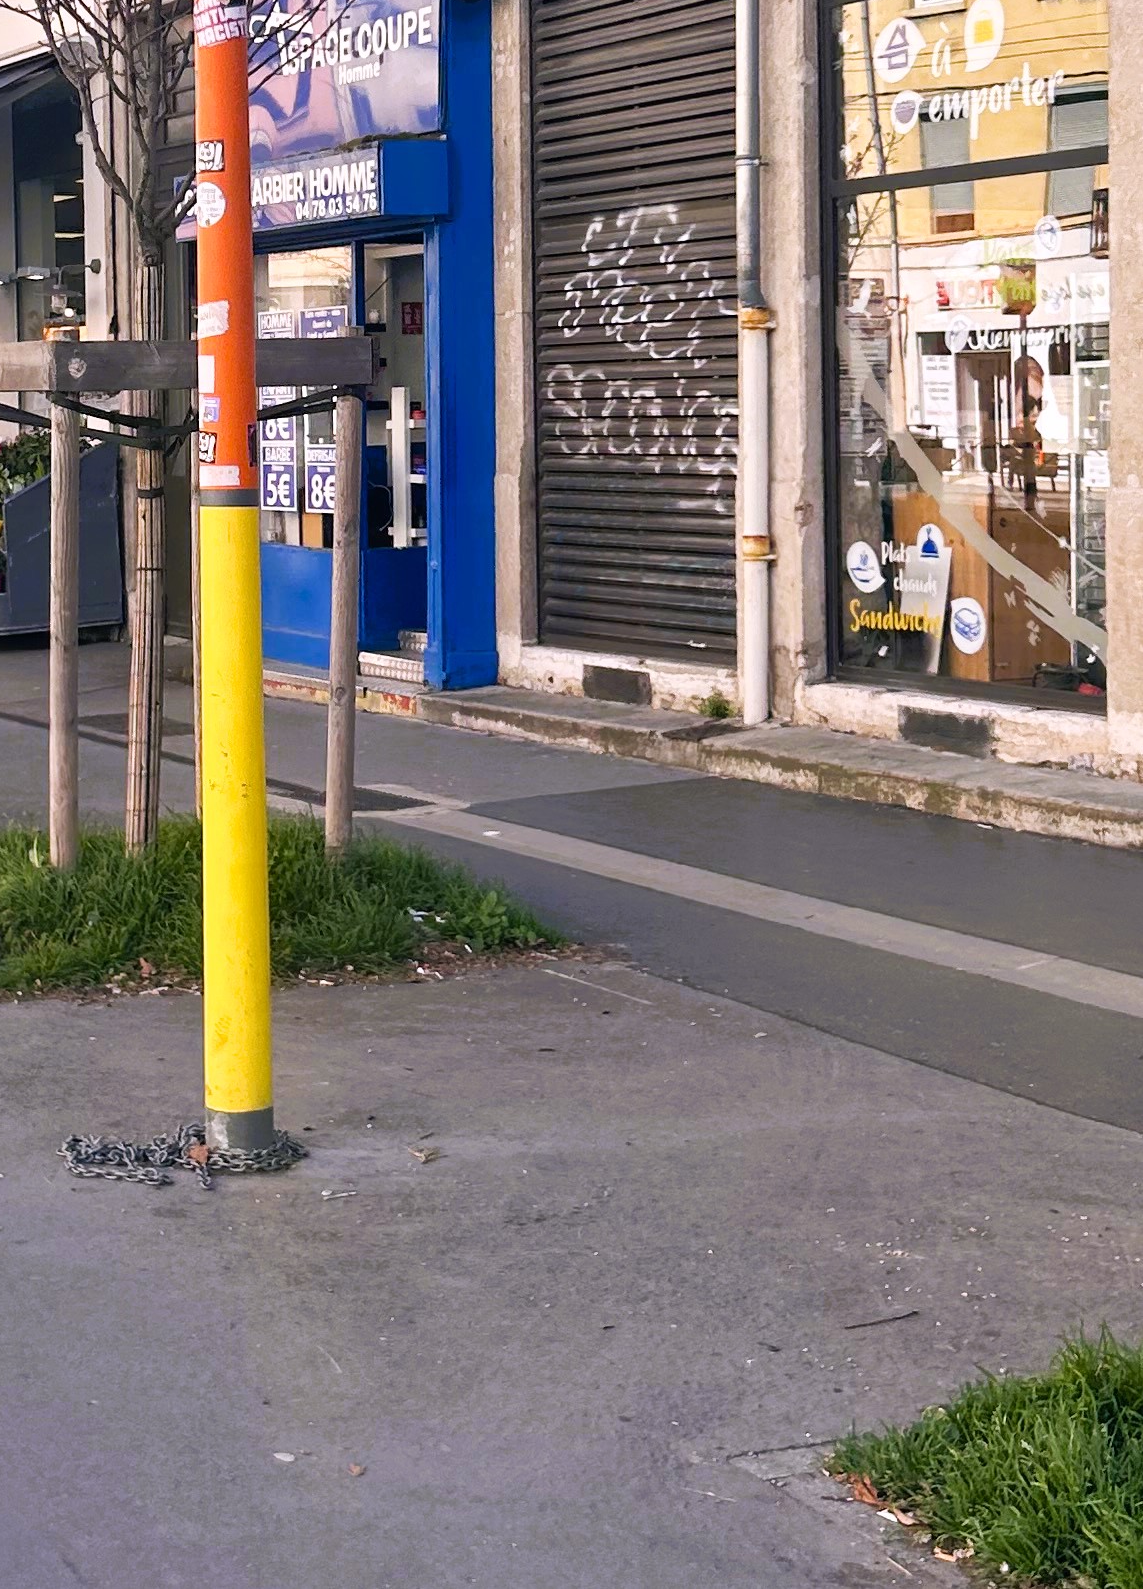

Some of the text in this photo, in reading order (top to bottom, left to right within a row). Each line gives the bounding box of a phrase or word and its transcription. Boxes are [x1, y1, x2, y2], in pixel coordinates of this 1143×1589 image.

[197, 20, 248, 46] RACIST
[357, 6, 433, 60] COUPE
[931, 21, 952, 78] à
[338, 60, 381, 86] Homme
[928, 61, 1065, 141] emporter
[251, 171, 305, 208] ARBIER
[309, 159, 377, 199] HOMME
[296, 191, 377, 221] 04 78 03 54 76
[261, 312, 292, 330] HOMME
[265, 447, 291, 462] BARBE
[266, 473, 291, 507] 5€
[311, 473, 336, 509] 8€
[881, 540, 911, 566] Plats
